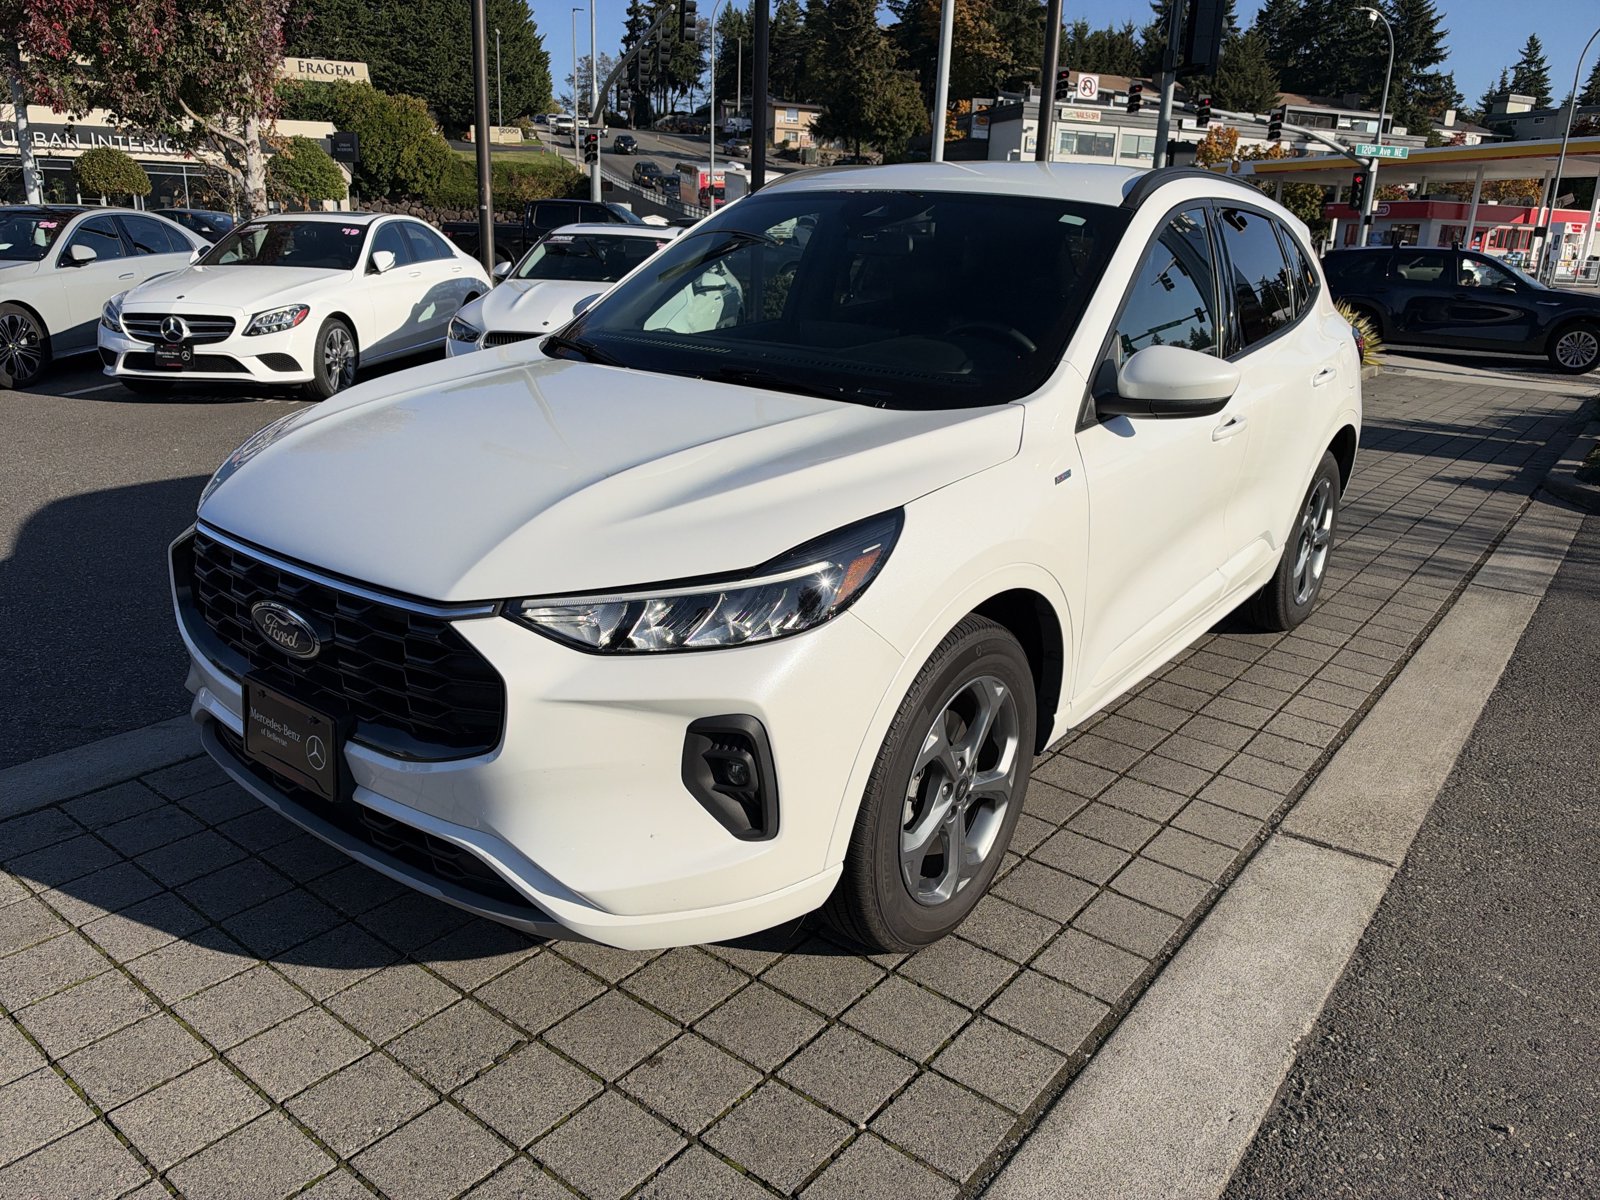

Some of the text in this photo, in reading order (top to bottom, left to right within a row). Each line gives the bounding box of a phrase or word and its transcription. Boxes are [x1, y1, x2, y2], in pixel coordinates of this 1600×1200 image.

[0, 129, 81, 148] UBAN
[1378, 147, 1391, 156] Ave
[1394, 148, 1403, 156] NE
[262, 612, 299, 649] Ford
[249, 706, 301, 742] Mercedes-Benz
[260, 728, 288, 747] of Bellevue
